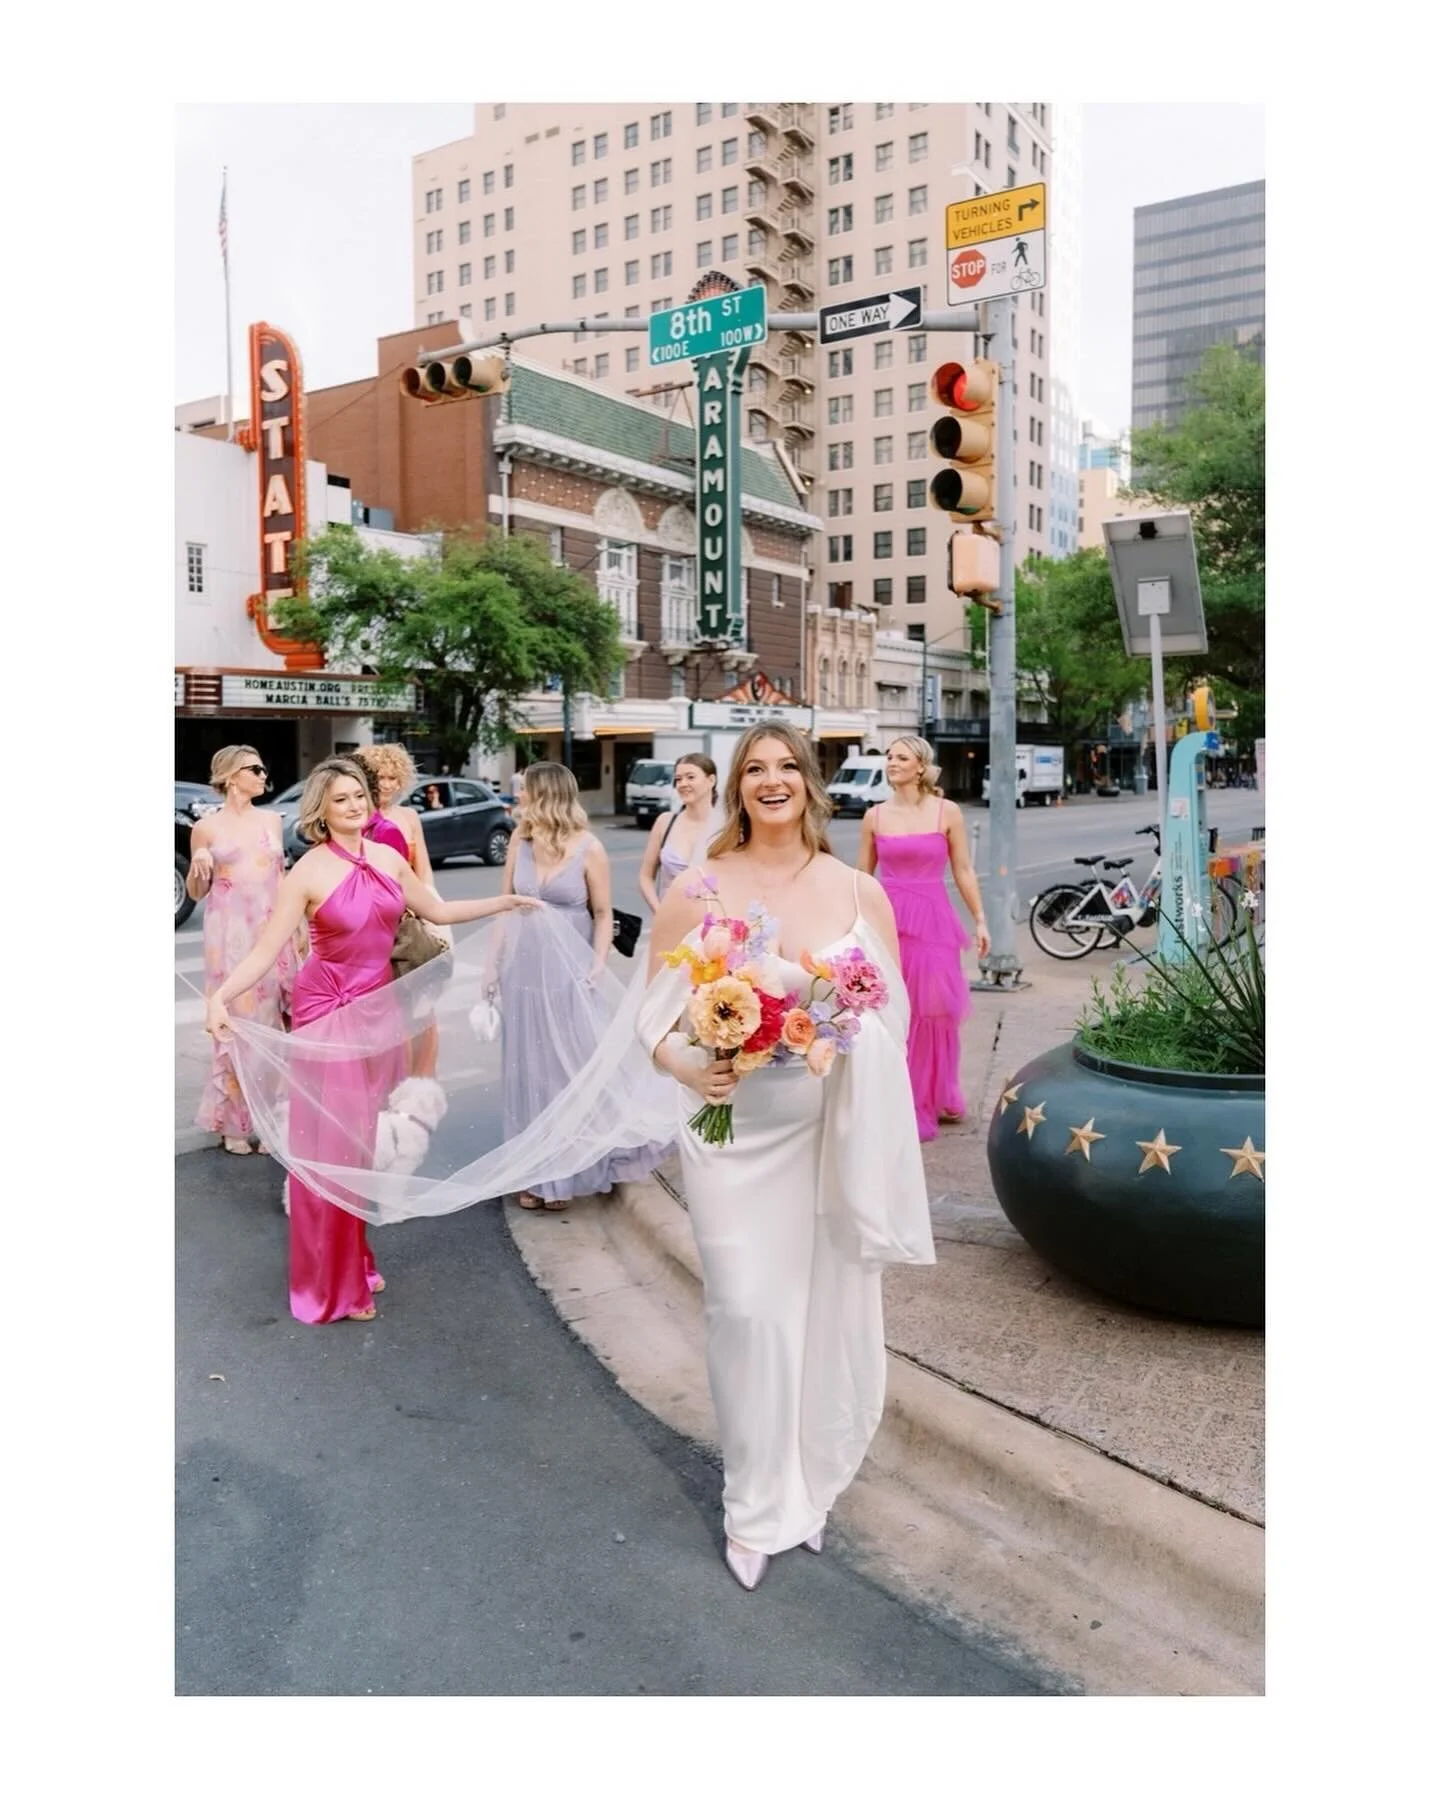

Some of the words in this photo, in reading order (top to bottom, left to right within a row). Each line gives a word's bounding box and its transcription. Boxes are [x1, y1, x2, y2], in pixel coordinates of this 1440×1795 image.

[954, 199, 1011, 221] TURNING
[952, 217, 1013, 241] VEHICLES
[951, 259, 985, 280] STOP
[991, 261, 1007, 275] FOR
[670, 306, 712, 340] 8th
[721, 296, 742, 316] ST
[830, 312, 856, 331] ONE
[861, 305, 889, 323] WAY
[660, 341, 690, 361] 100E
[720, 328, 753, 347] 100W
[703, 355, 724, 628] ARAMOUNT
[244, 679, 341, 693] HOMEAUSTIN.ORG
[266, 694, 308, 705] MARCIA
[316, 695, 350, 706] BALL'S
